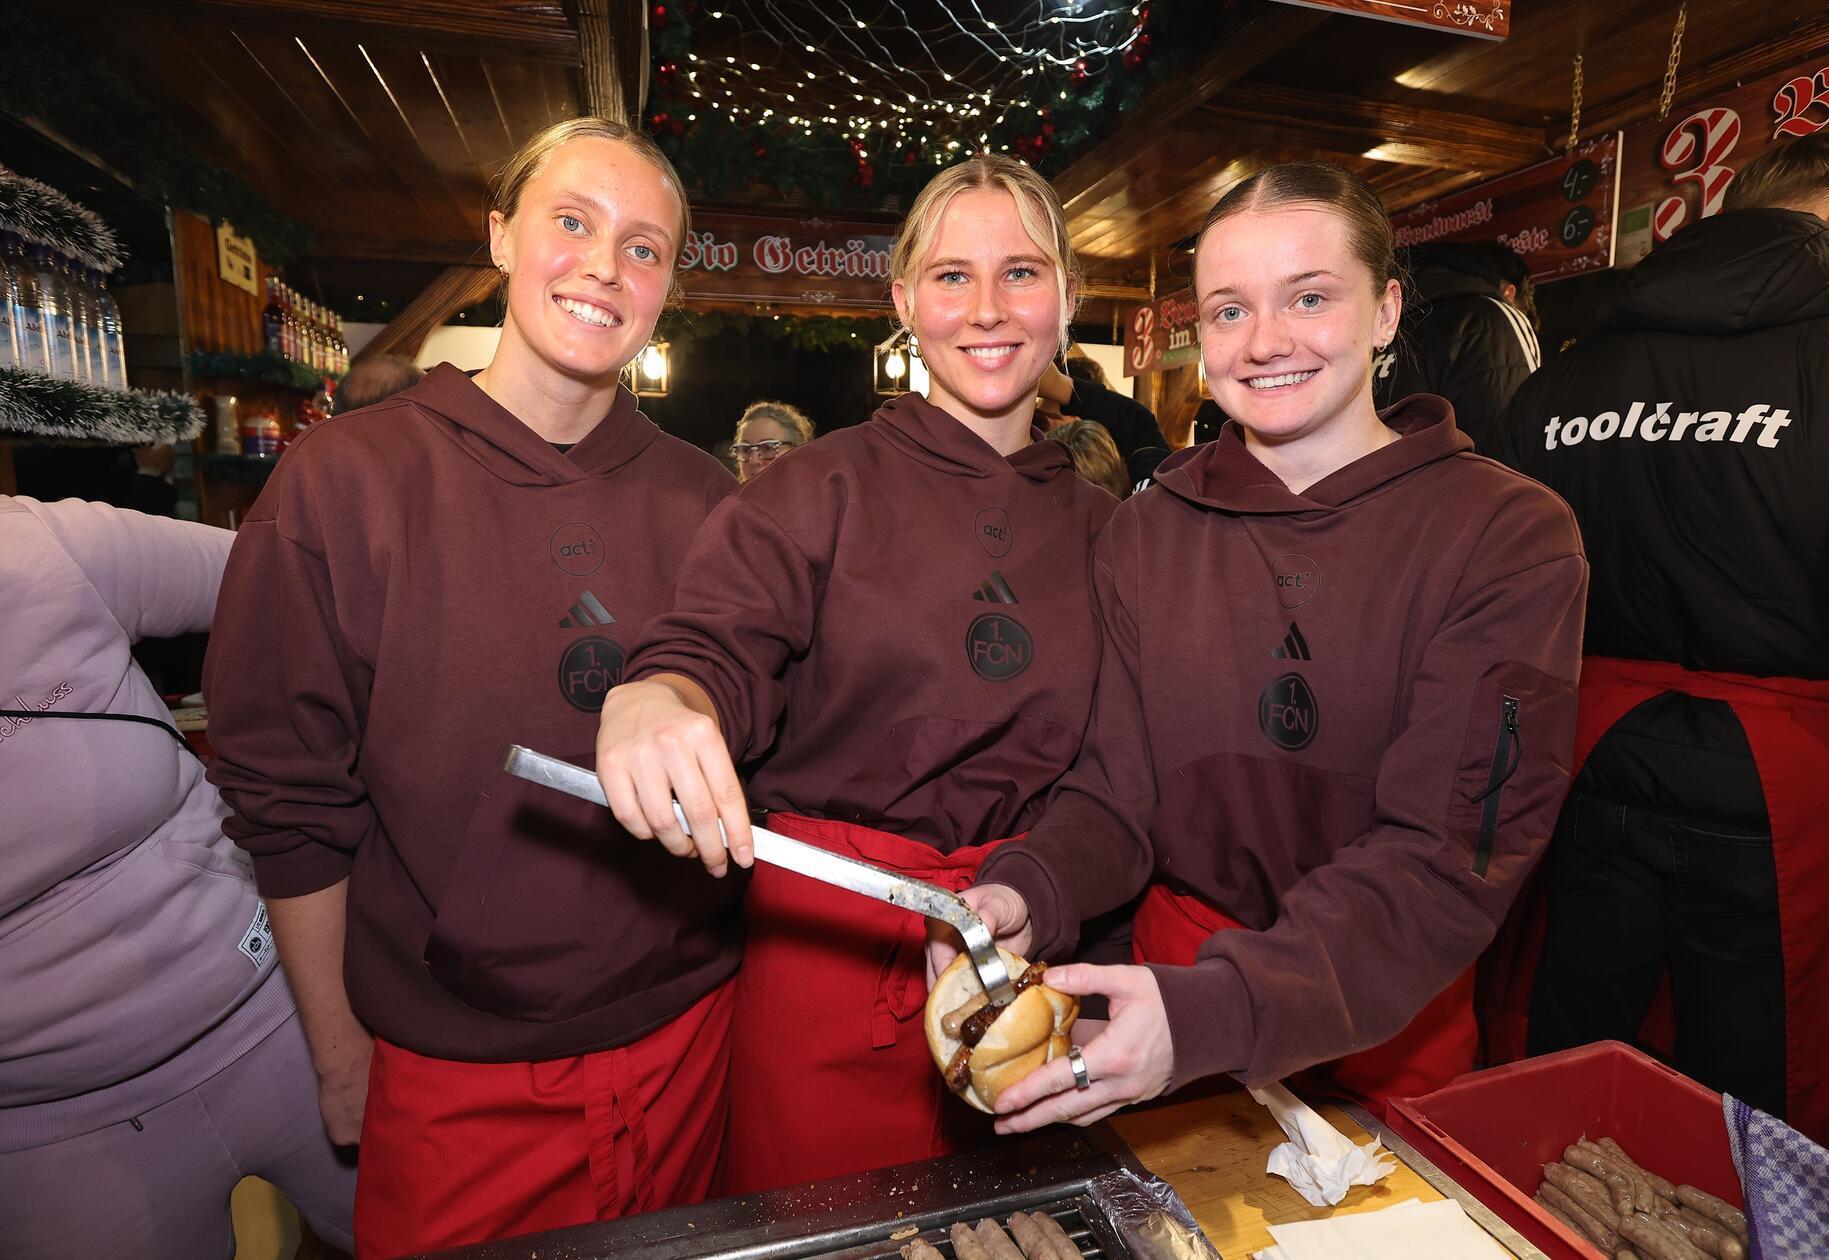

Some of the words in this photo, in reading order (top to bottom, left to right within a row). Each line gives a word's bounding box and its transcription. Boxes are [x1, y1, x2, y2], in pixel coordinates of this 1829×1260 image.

[1168, 327, 1191, 350] im
[1545, 401, 1792, 450] toolcraft
[973, 640, 1024, 665] FCN
[568, 667, 621, 696] FCN
[1267, 704, 1309, 733] FCN
